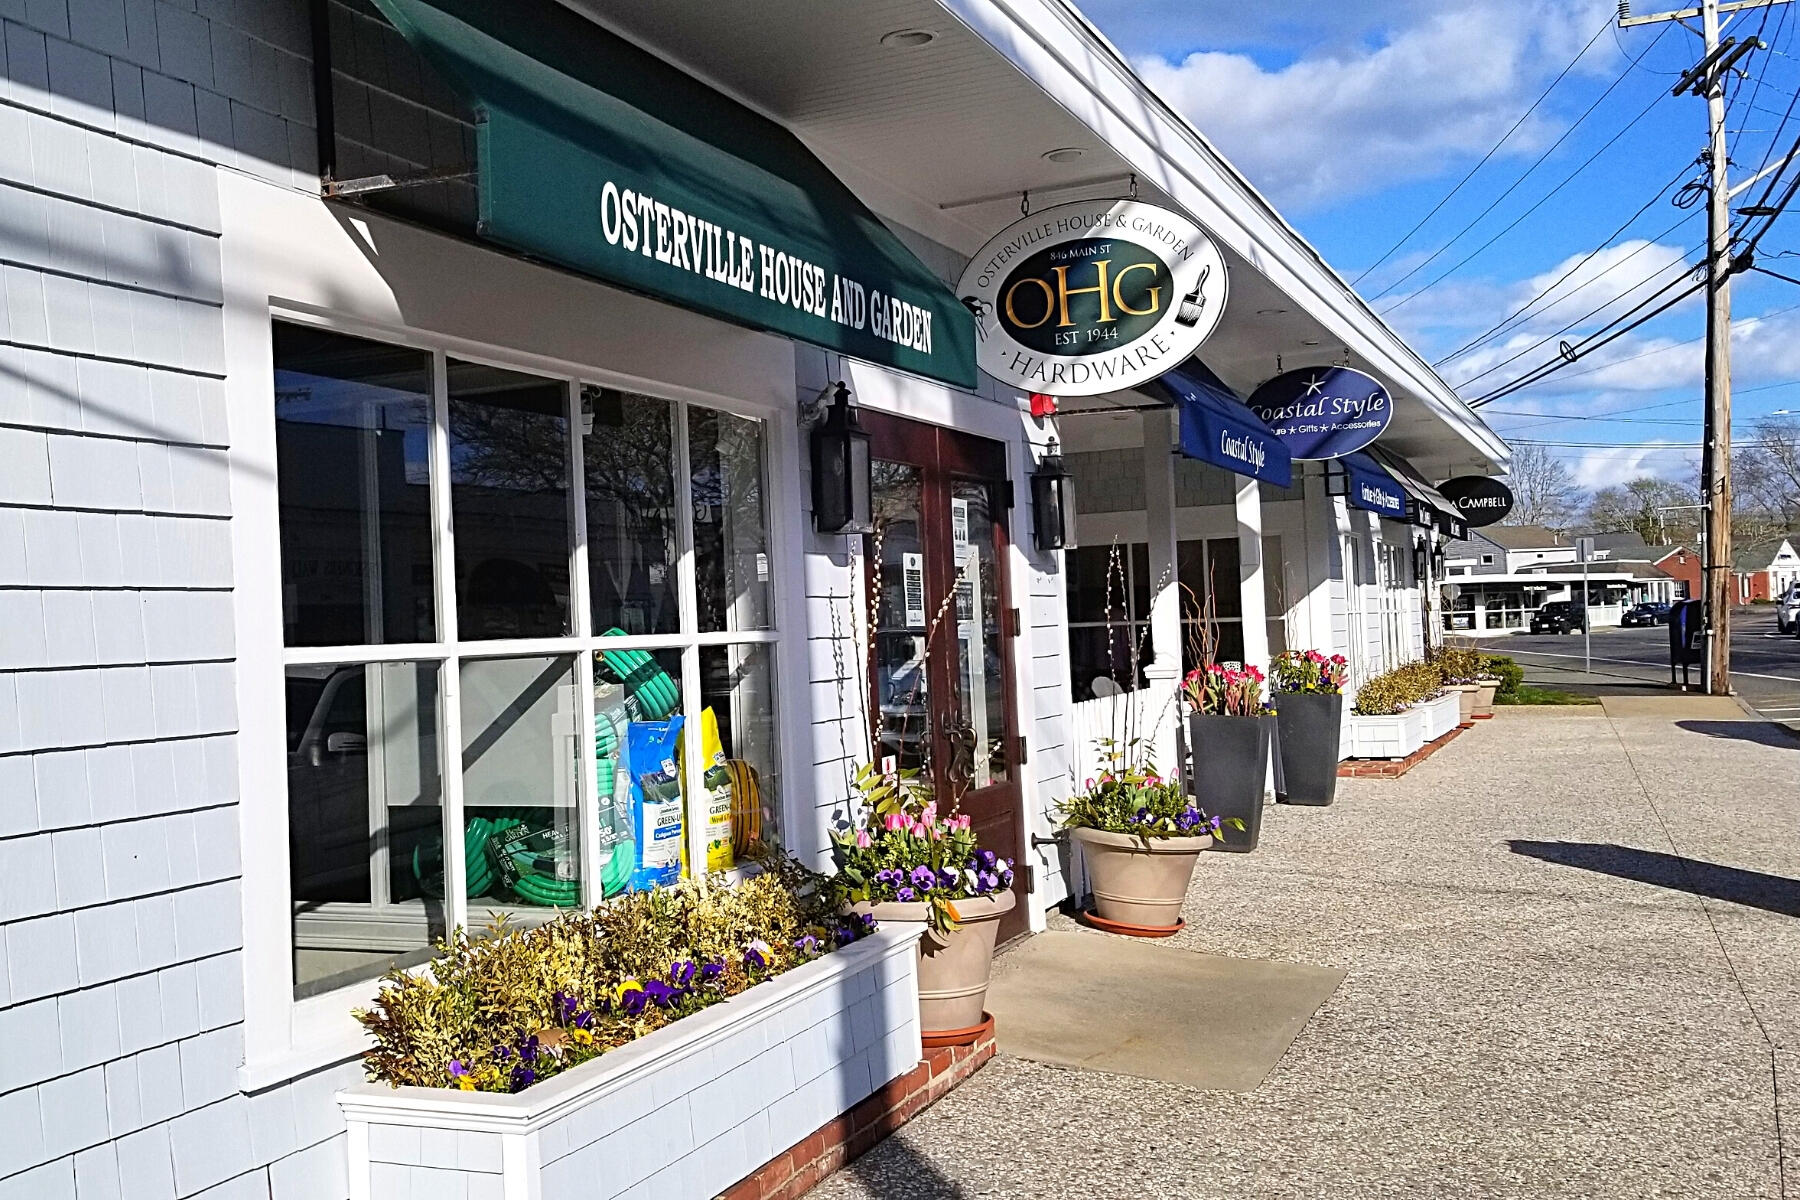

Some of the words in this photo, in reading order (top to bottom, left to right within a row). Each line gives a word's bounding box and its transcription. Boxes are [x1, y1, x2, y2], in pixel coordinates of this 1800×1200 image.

[601, 181, 754, 293] OSTERVILLE
[759, 243, 826, 318] HOUSE
[831, 274, 866, 330] AND
[870, 289, 932, 354] GARDEN
[978, 223, 1054, 288] OSTERVILLE
[1056, 213, 1112, 234] HOUSE
[1116, 214, 1127, 228] &
[1132, 217, 1194, 262] GARDEN
[1050, 249, 1067, 260] 846
[1069, 247, 1098, 259] MAIN
[1099, 243, 1112, 254] ST
[1006, 259, 1163, 329] OHG
[1055, 331, 1079, 346] EST
[1087, 327, 1119, 342] 1944
[1009, 334, 1170, 384] HARDWARE
[1331, 392, 1385, 419] Style
[1298, 424, 1318, 433] Gifts
[1331, 420, 1381, 430] Accessories
[1221, 430, 1249, 462] Coastal
[1248, 441, 1265, 474] Style
[1459, 496, 1507, 509] CAMPBELL
